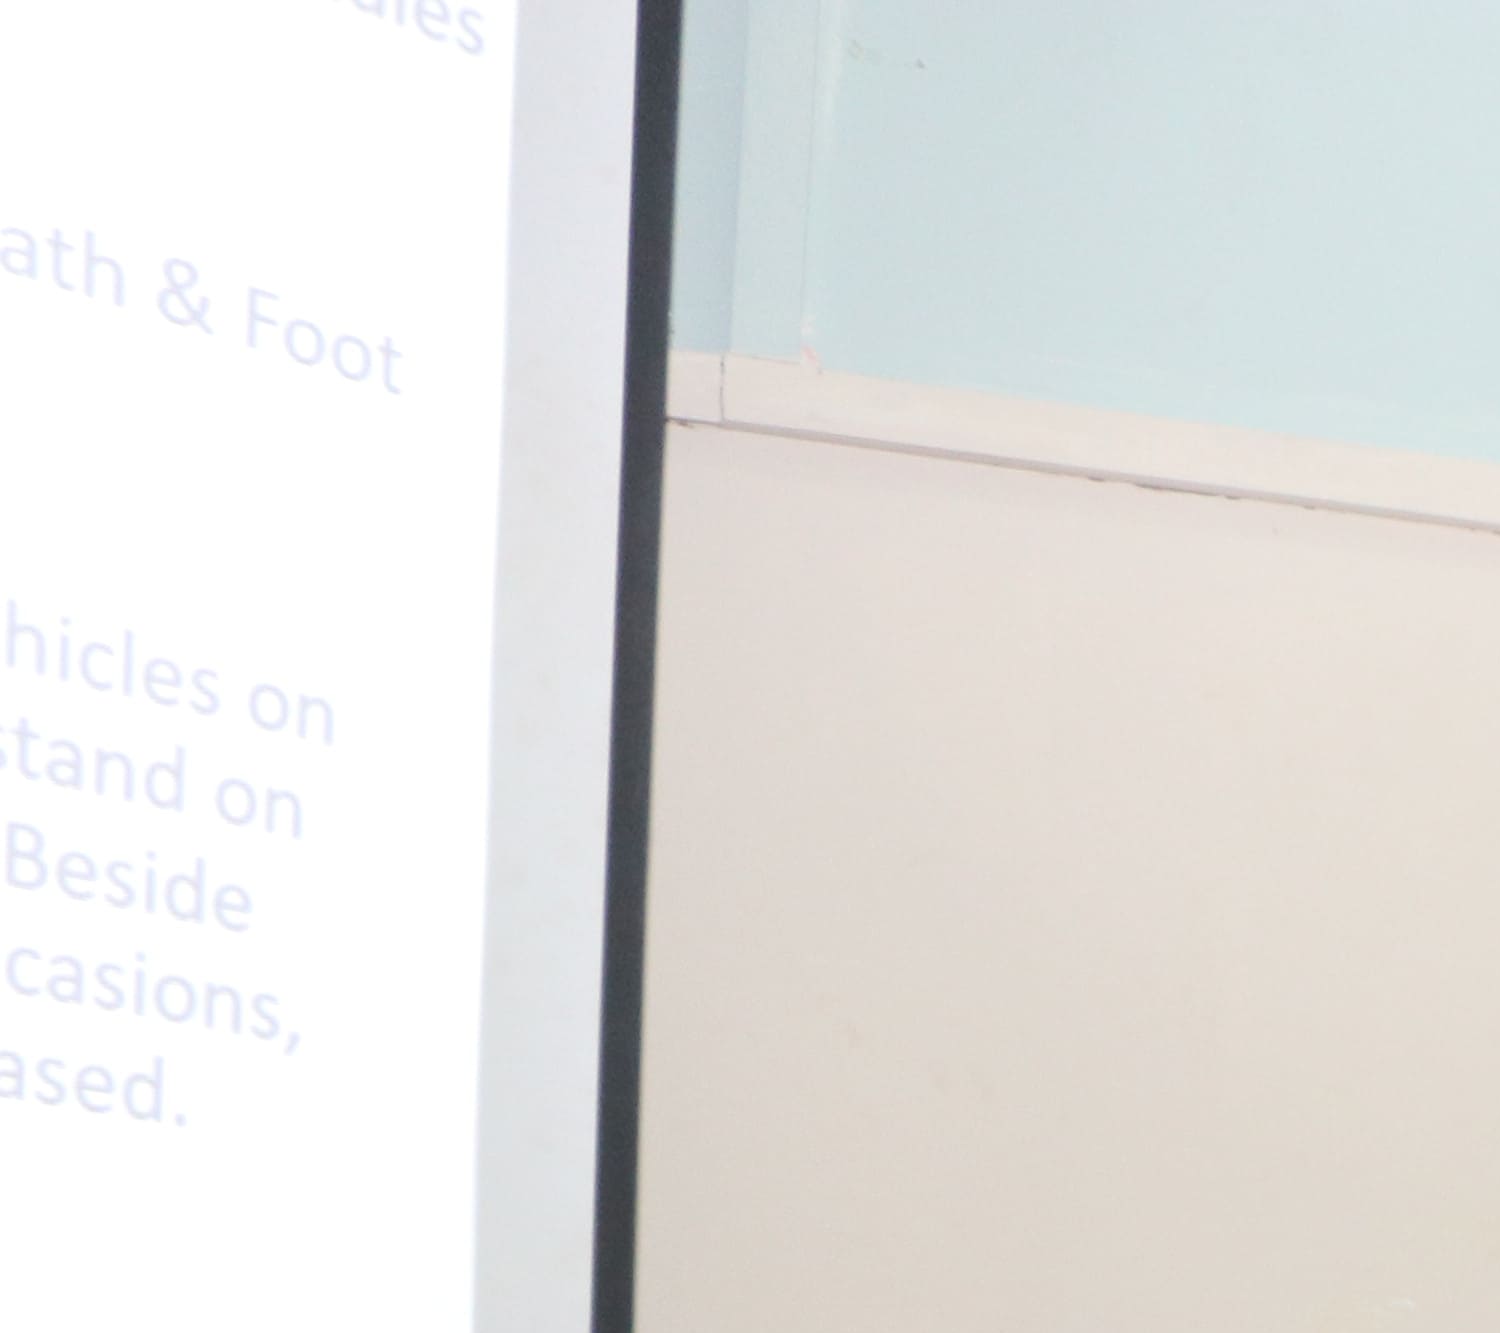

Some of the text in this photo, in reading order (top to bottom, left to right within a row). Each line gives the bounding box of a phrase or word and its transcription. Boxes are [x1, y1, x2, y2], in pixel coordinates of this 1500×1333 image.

[0, 226, 404, 395] ath & Foot
[4, 598, 334, 746] hicles on
[215, 778, 302, 839] on
[4, 820, 252, 933] Beside
[5, 946, 302, 1057] casions,
[0, 1050, 187, 1127] ased.
